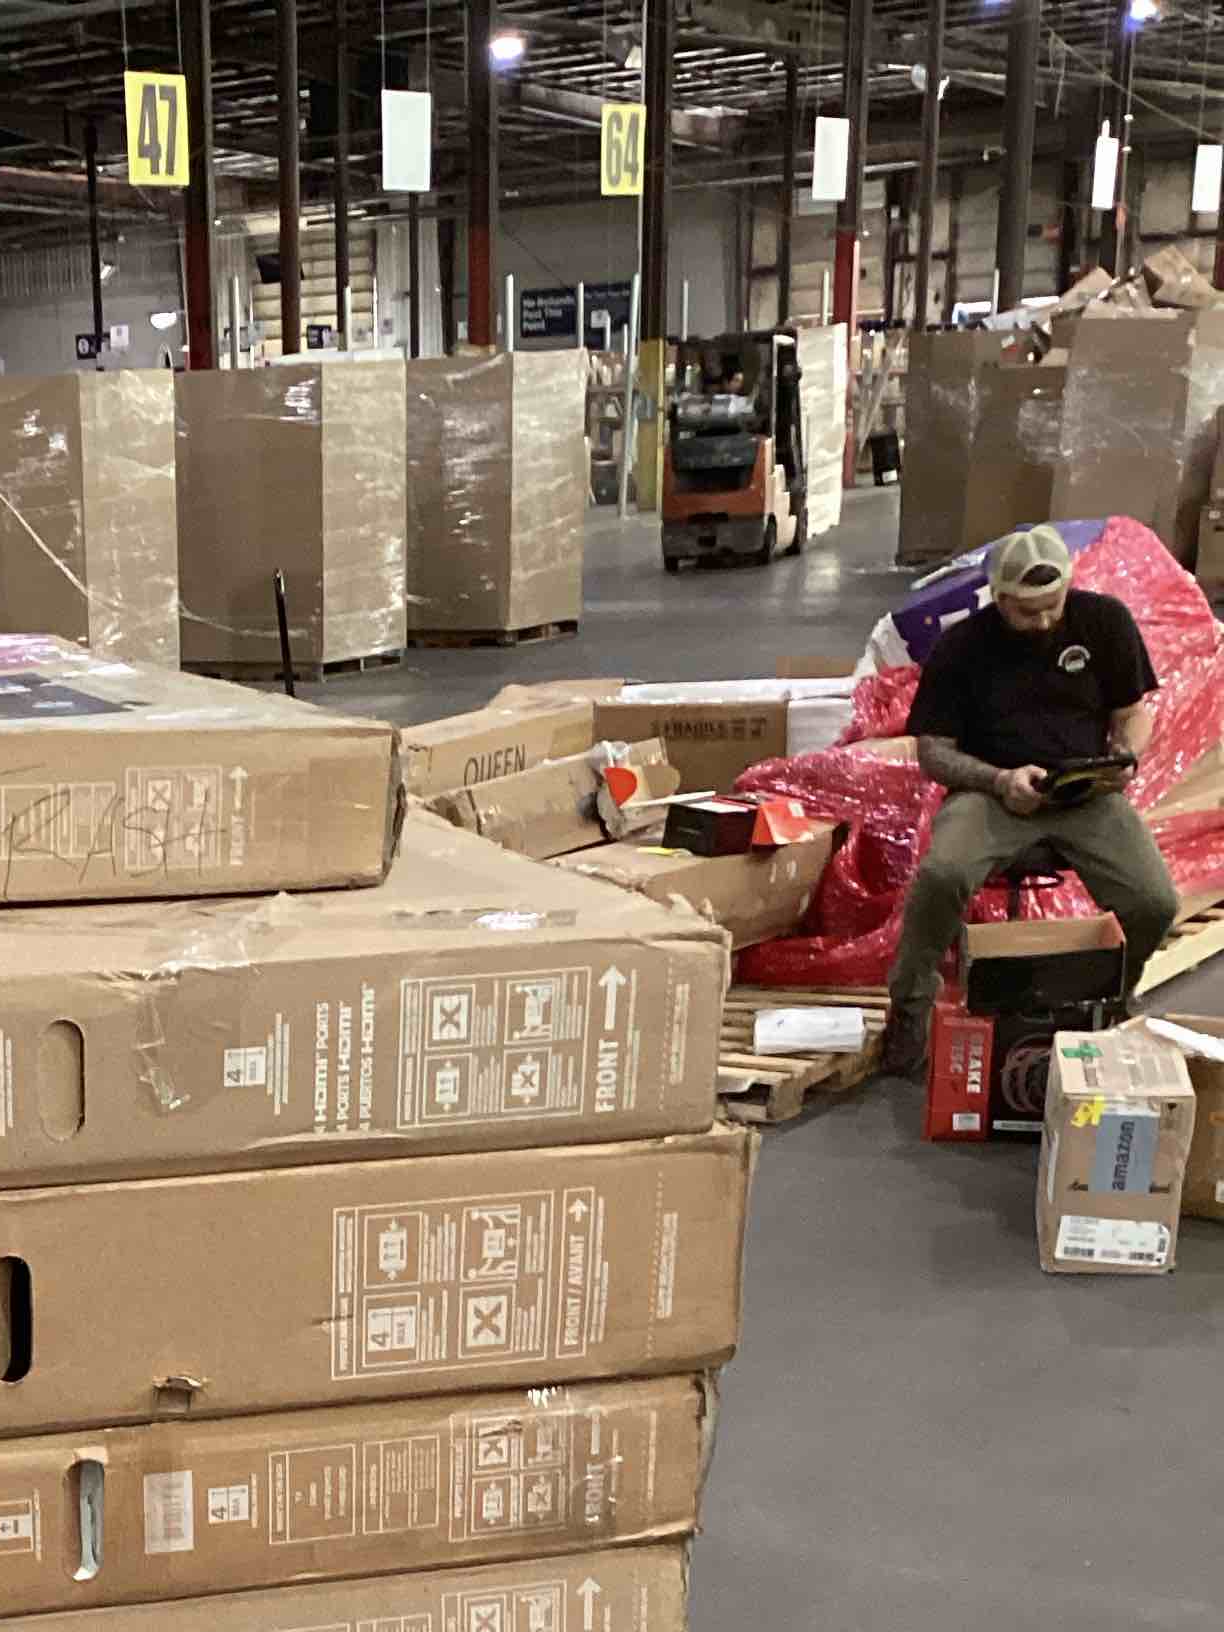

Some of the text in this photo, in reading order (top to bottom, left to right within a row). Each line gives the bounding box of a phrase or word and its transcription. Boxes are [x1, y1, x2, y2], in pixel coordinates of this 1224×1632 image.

[137, 83, 178, 176] 47
[603, 121, 642, 190] 64
[594, 1038, 620, 1114] FRONT
[1112, 1120, 1136, 1192] amazon
[210, 1505, 227, 1521] 4
